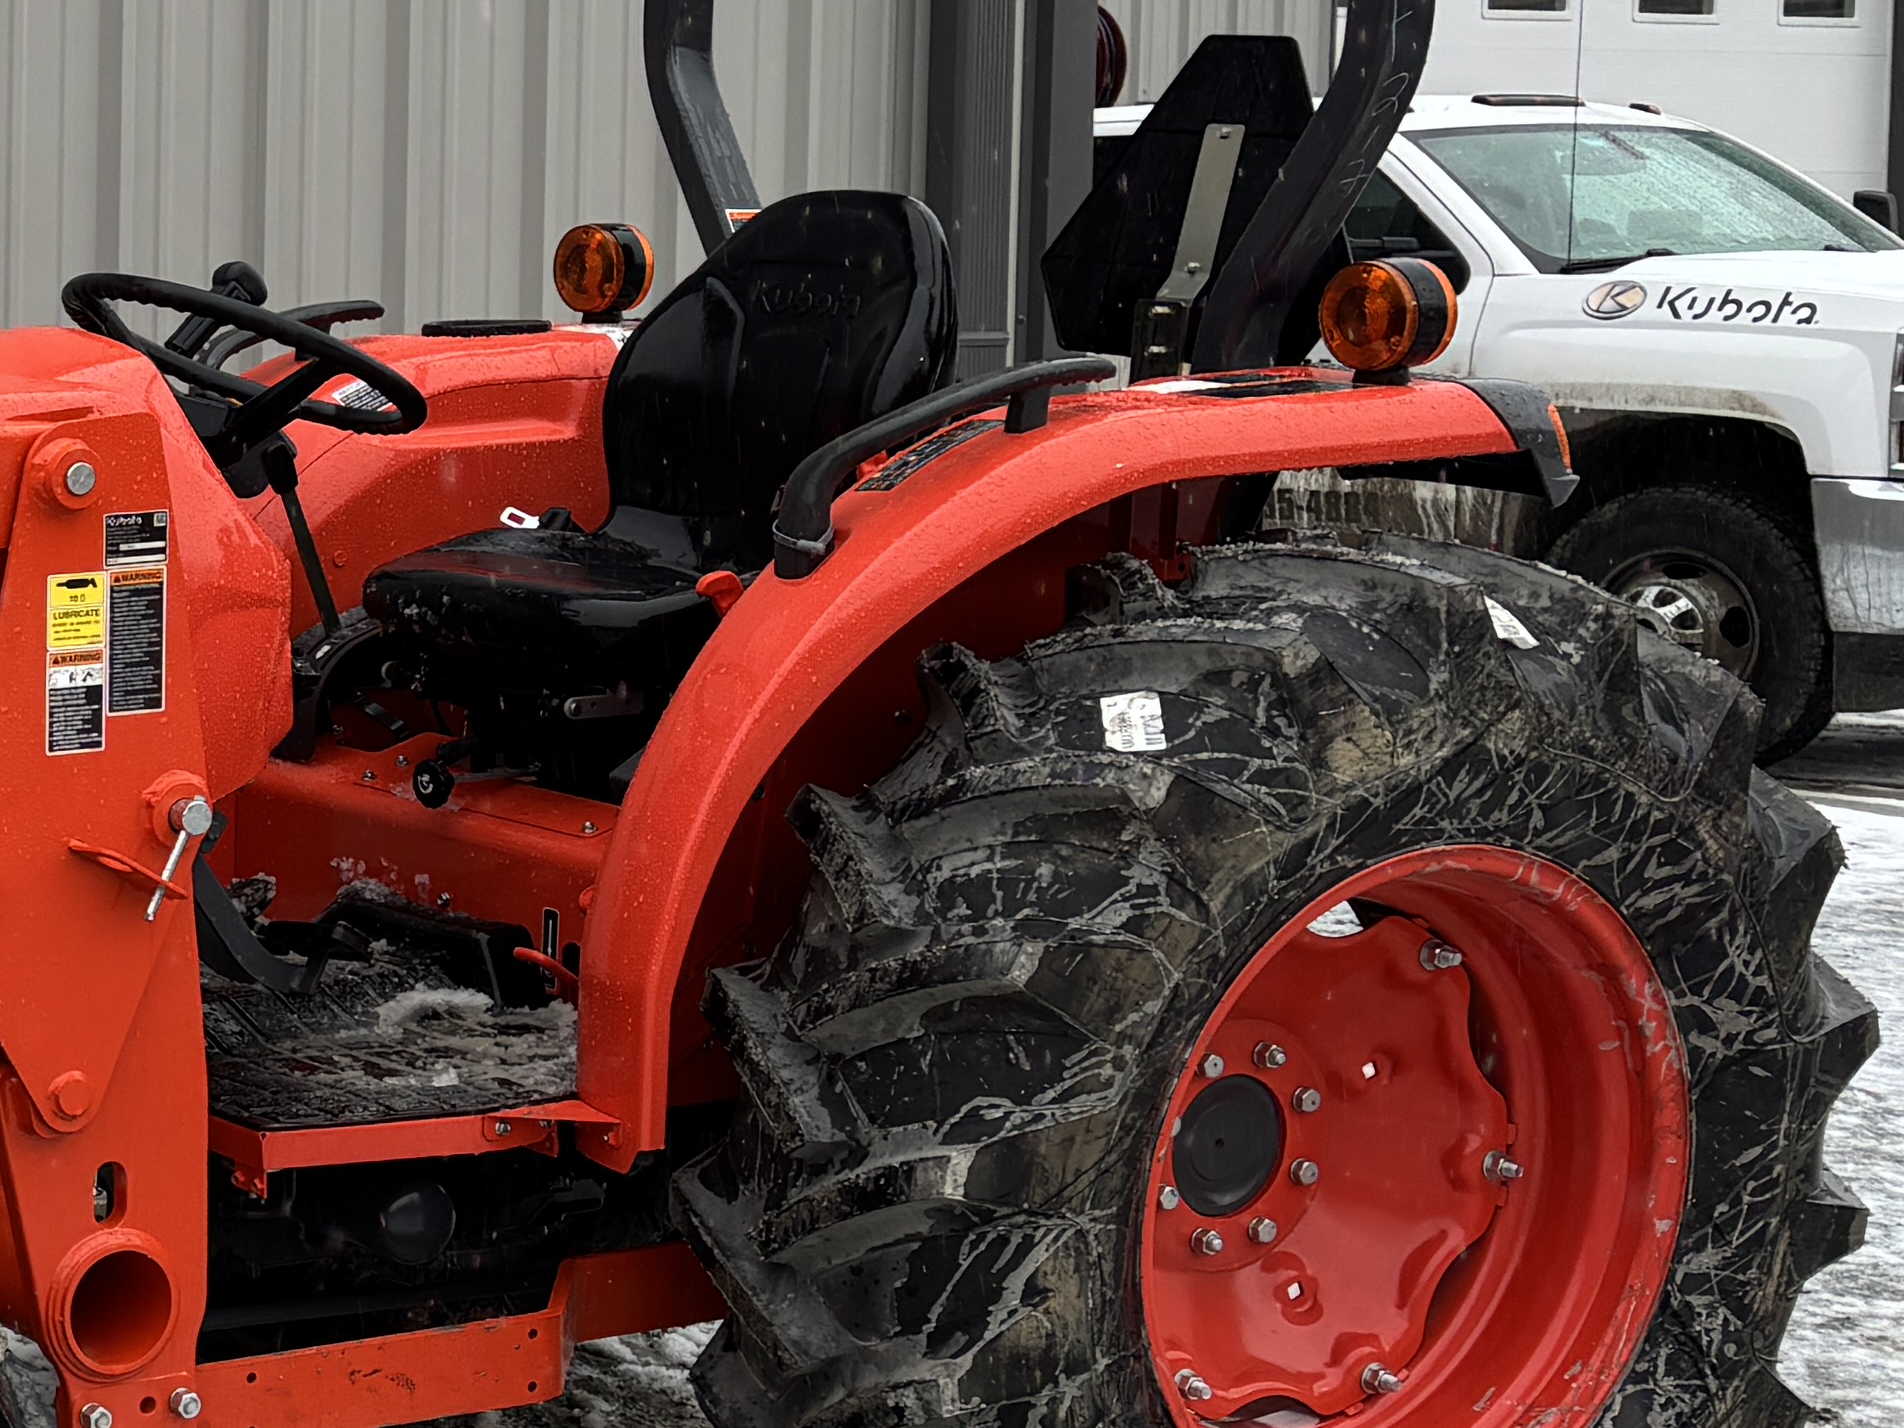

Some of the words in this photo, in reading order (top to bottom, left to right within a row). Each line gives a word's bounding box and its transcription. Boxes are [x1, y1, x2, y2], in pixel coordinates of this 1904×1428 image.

[1656, 285, 1818, 326] Kubota
[121, 571, 163, 582] WARNING
[52, 608, 100, 621] LUBRICATE
[60, 653, 102, 665] WARNING
